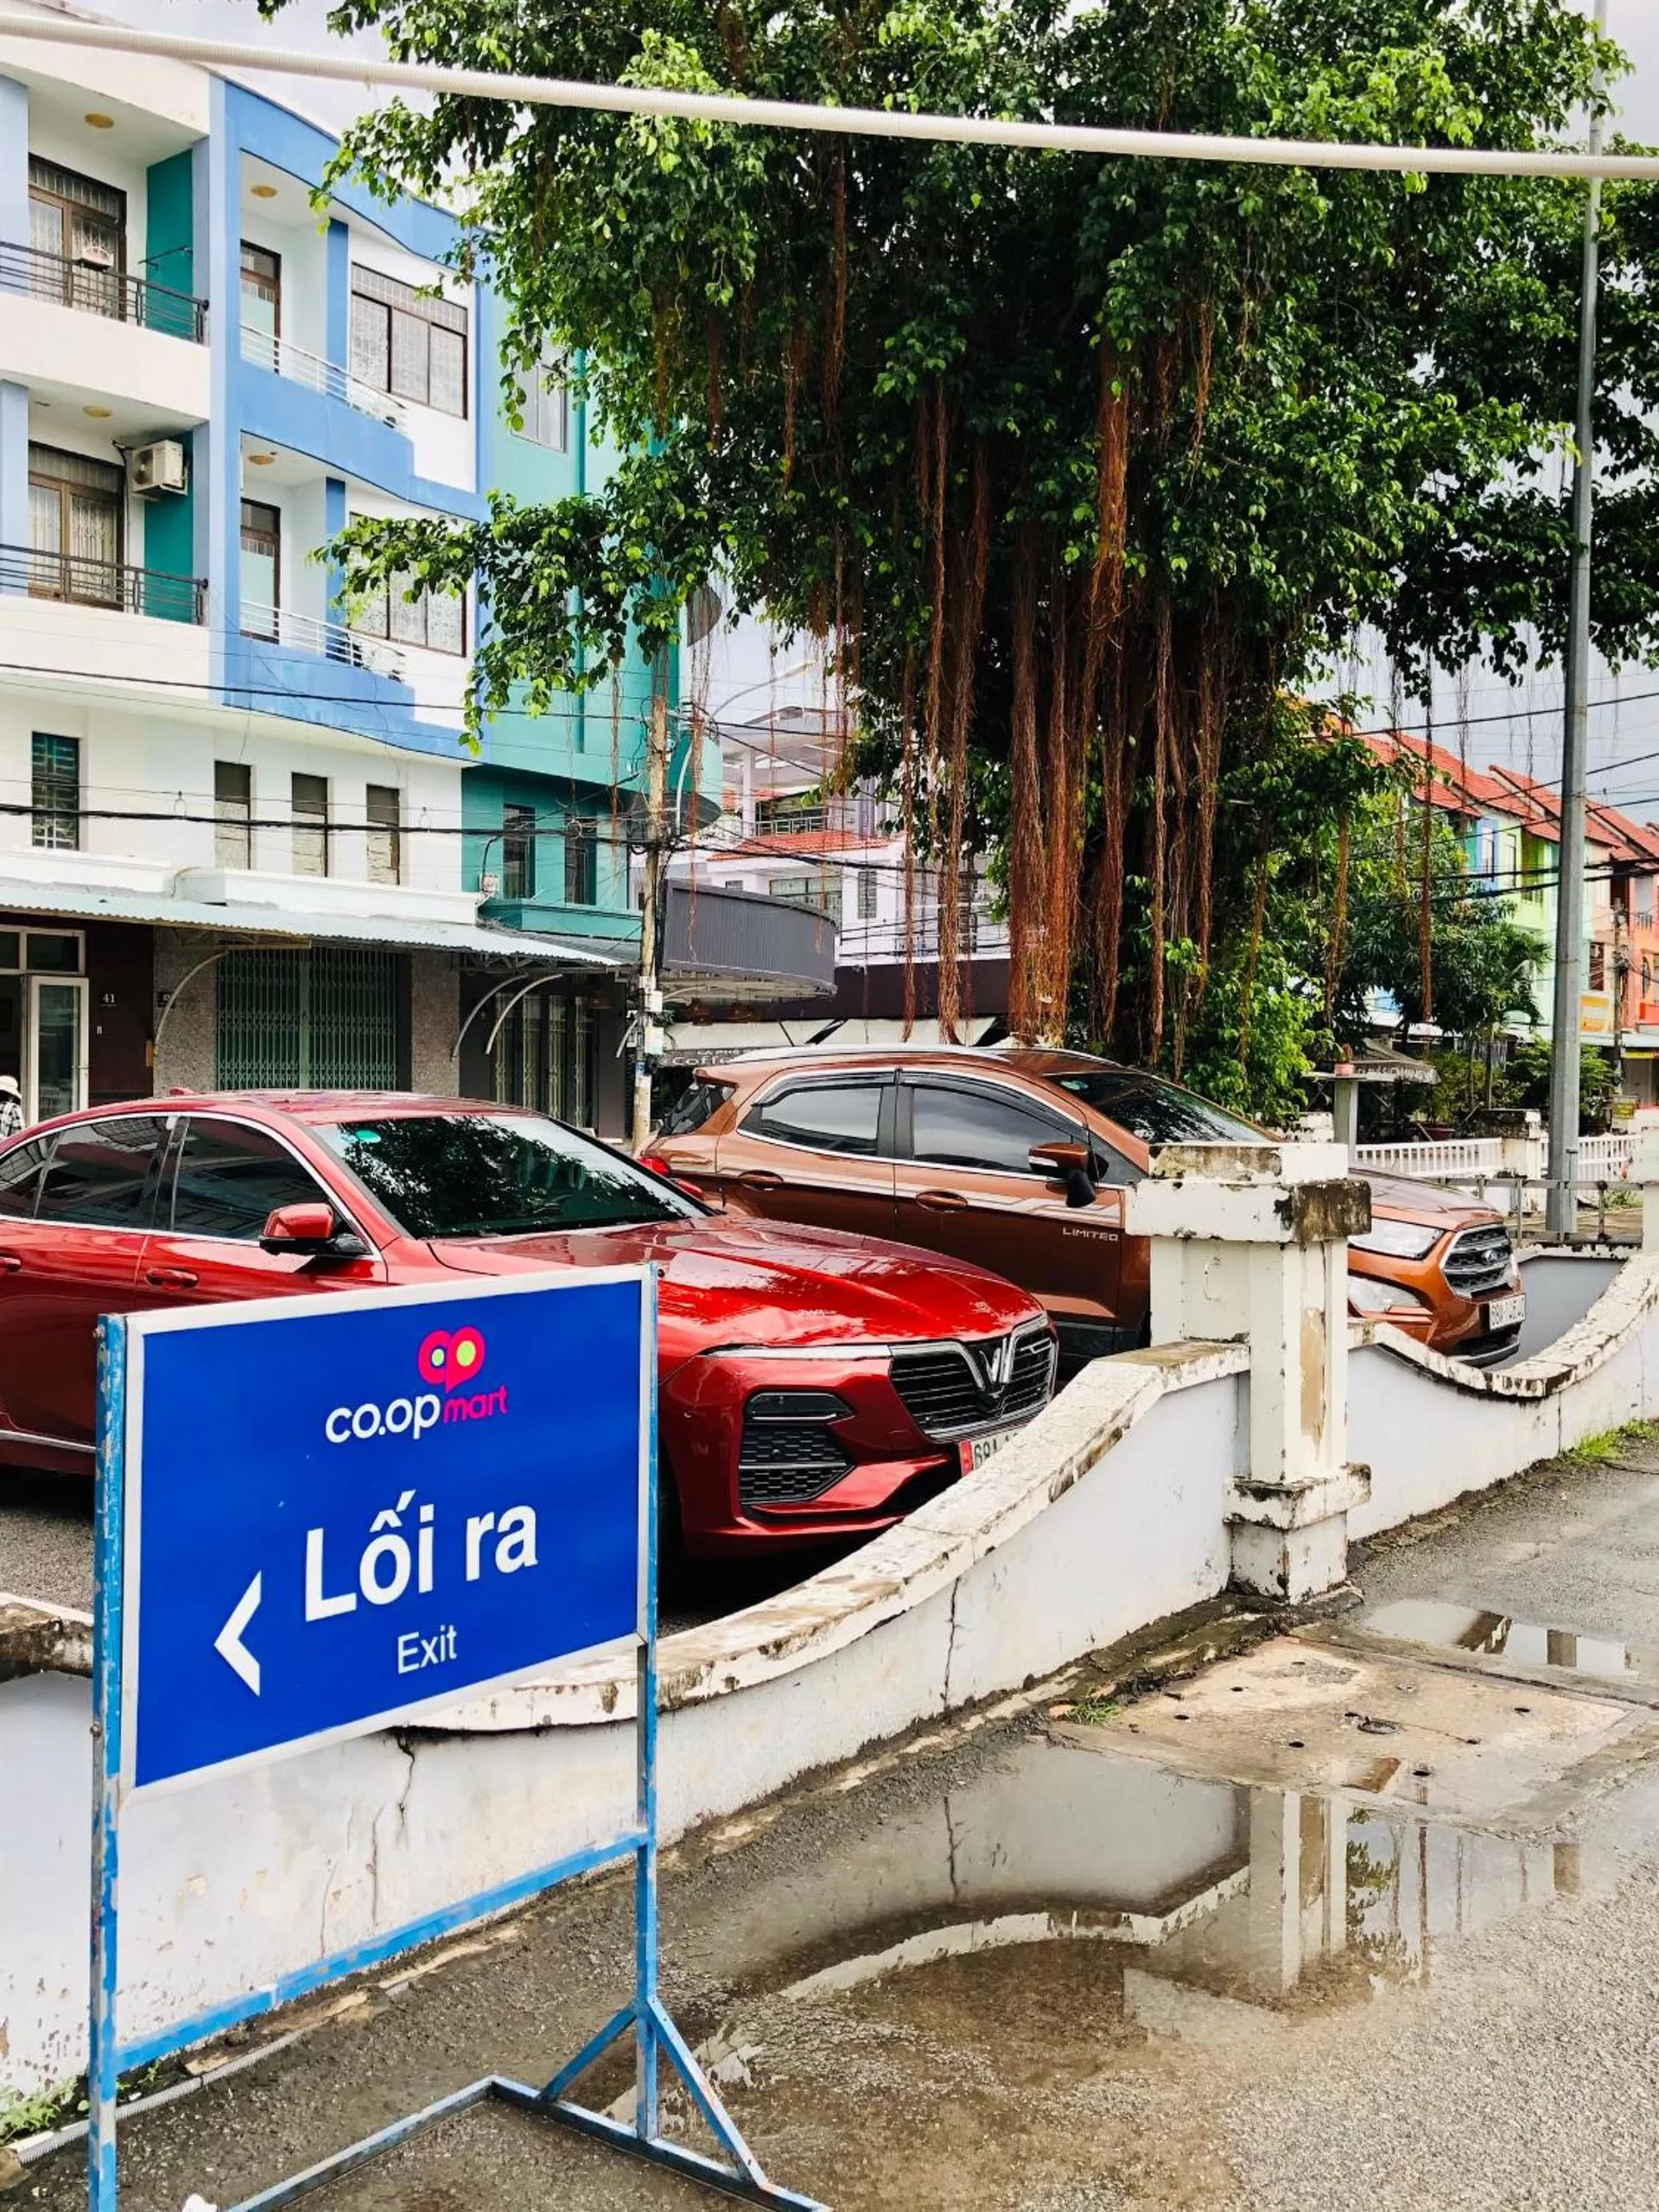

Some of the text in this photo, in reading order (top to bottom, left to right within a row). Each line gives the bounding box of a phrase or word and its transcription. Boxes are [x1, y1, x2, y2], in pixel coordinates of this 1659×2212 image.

[672, 1055, 734, 1065] Coffe
[1062, 1227, 1119, 1241] LIMITED
[306, 1490, 538, 1622] Lối ra
[397, 1624, 457, 1675] Exit
